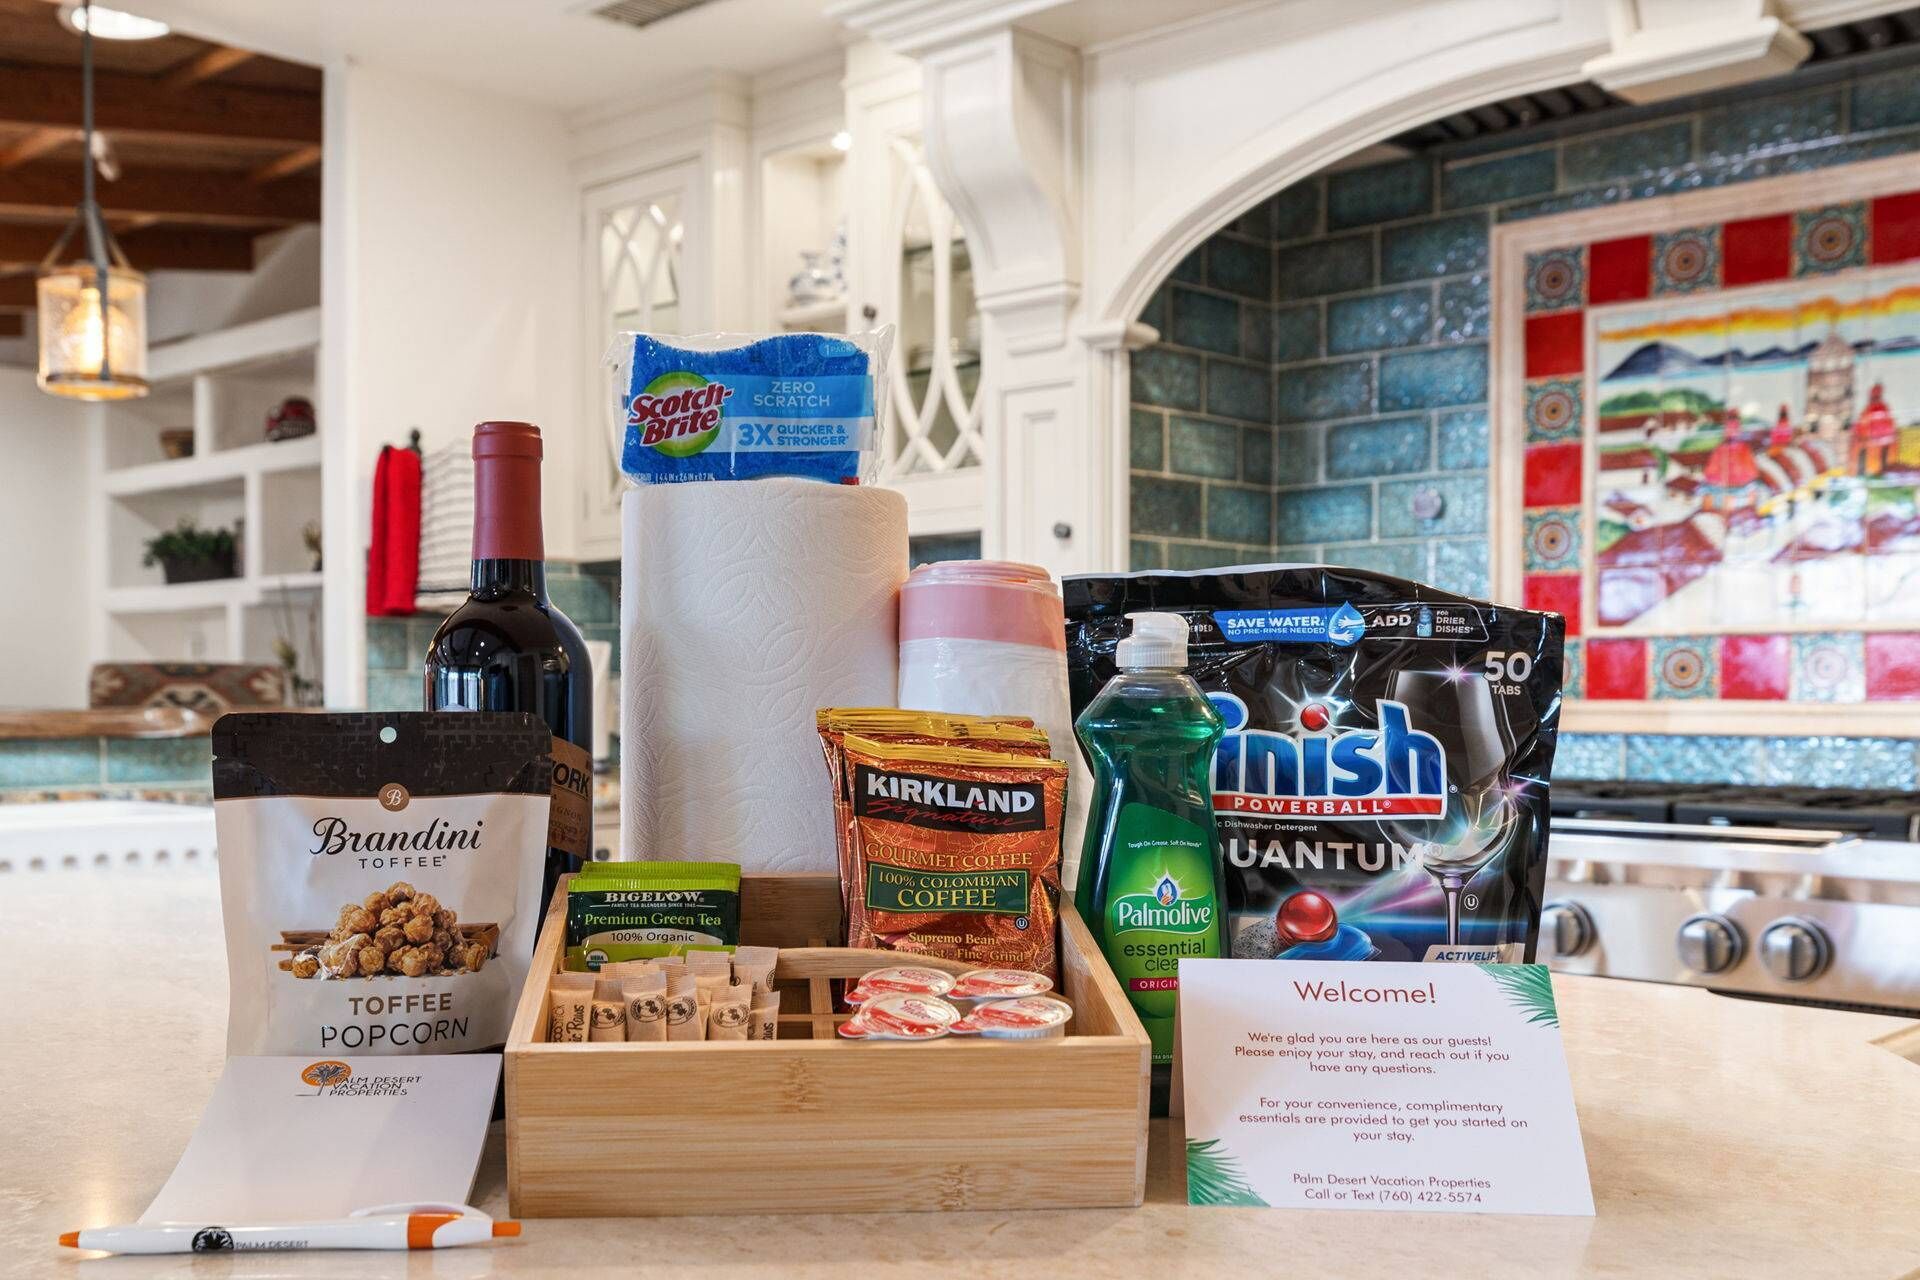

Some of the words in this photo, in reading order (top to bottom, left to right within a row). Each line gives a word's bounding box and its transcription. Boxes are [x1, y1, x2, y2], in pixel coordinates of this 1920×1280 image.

[771, 381, 816, 394] ZERO
[628, 382, 734, 425] Scotch-
[753, 394, 831, 408] SCRATCH
[640, 407, 720, 447] Brite
[737, 423, 774, 447] 3X
[777, 424, 833, 435] QUICKER
[836, 424, 846, 435] &
[1227, 617, 1266, 629] SAVE
[1372, 614, 1411, 628] ADD
[1436, 616, 1466, 625] DRIER
[1290, 627, 1326, 635] NEEDED
[1484, 651, 1532, 682] 50
[1492, 685, 1521, 696] TABS
[1208, 693, 1445, 797] inish
[552, 761, 590, 799] ORK
[867, 773, 1036, 814] KIRKLAND
[866, 799, 1037, 828] Signature
[1224, 820, 1273, 831] Dishwasher
[1275, 823, 1318, 833] Detergent
[310, 816, 483, 855] Brandini
[1128, 841, 1143, 849] Tough
[865, 842, 962, 868] GOURMET
[962, 851, 1033, 868] COFFEE
[878, 871, 915, 888] 100%
[920, 875, 1019, 888] COLOMBIAN
[604, 891, 703, 903] BIGELOW
[897, 888, 996, 907] COFFEE
[584, 913, 648, 926] Premium
[651, 912, 694, 925] Green
[698, 914, 721, 926] Tea
[1119, 900, 1211, 927] Palmolive
[611, 932, 643, 942] 100%
[646, 932, 695, 944] Organic
[908, 932, 962, 949] Supremo
[1123, 938, 1206, 957] essential
[956, 949, 982, 960] Fine
[989, 950, 1026, 963] Grind
[1145, 957, 1178, 972] clea
[1293, 980, 1436, 1004] Welcome!
[348, 992, 452, 1016] TOFFEE
[321, 1016, 469, 1049] POPCORN
[1248, 1031, 1283, 1043] We're
[1287, 1032, 1315, 1045] glad
[1319, 1035, 1342, 1046] you
[1346, 1036, 1367, 1044] are
[1371, 1033, 1400, 1045] here
[1403, 1036, 1418, 1045] as
[1422, 1037, 1443, 1045] our
[1448, 1036, 1492, 1047] guests!
[1235, 1046, 1275, 1057] Please
[1279, 1046, 1313, 1060] enjoy
[1316, 1049, 1344, 1060] your
[1348, 1049, 1376, 1060] stay,
[1380, 1049, 1405, 1059] and
[1410, 1049, 1446, 1060] reach
[1450, 1050, 1470, 1061] out
[1474, 1050, 1482, 1060] if
[1486, 1052, 1510, 1063] you
[1309, 1061, 1341, 1073] have
[1344, 1063, 1368, 1075] any
[1372, 1063, 1436, 1075] questions.
[1260, 1097, 1280, 1108] For
[1284, 1099, 1313, 1110] your
[1317, 1099, 1401, 1111] convenience,
[1406, 1100, 1504, 1114] complimentary
[1239, 1112, 1301, 1124] essentials
[1304, 1115, 1326, 1124] are
[1331, 1113, 1387, 1126] provided
[1392, 1115, 1405, 1125] to
[1409, 1116, 1429, 1128] get
[1433, 1118, 1457, 1128] you
[1462, 1117, 1506, 1127] started
[1511, 1119, 1528, 1128] on
[1353, 1131, 1382, 1142] your
[1387, 1131, 1415, 1143] stay.
[1293, 1173, 1323, 1184] Palm
[1327, 1174, 1367, 1186] Desert
[1370, 1175, 1425, 1187] Vacation
[1429, 1176, 1491, 1190] Properties
[1304, 1188, 1330, 1200] Call
[1334, 1191, 1347, 1200] or
[1351, 1189, 1375, 1201] Text
[1379, 1190, 1413, 1204] (760)
[1417, 1191, 1482, 1203] 422-5574
[236, 1240, 265, 1249] PALM
[268, 1239, 309, 1249] DESERT
